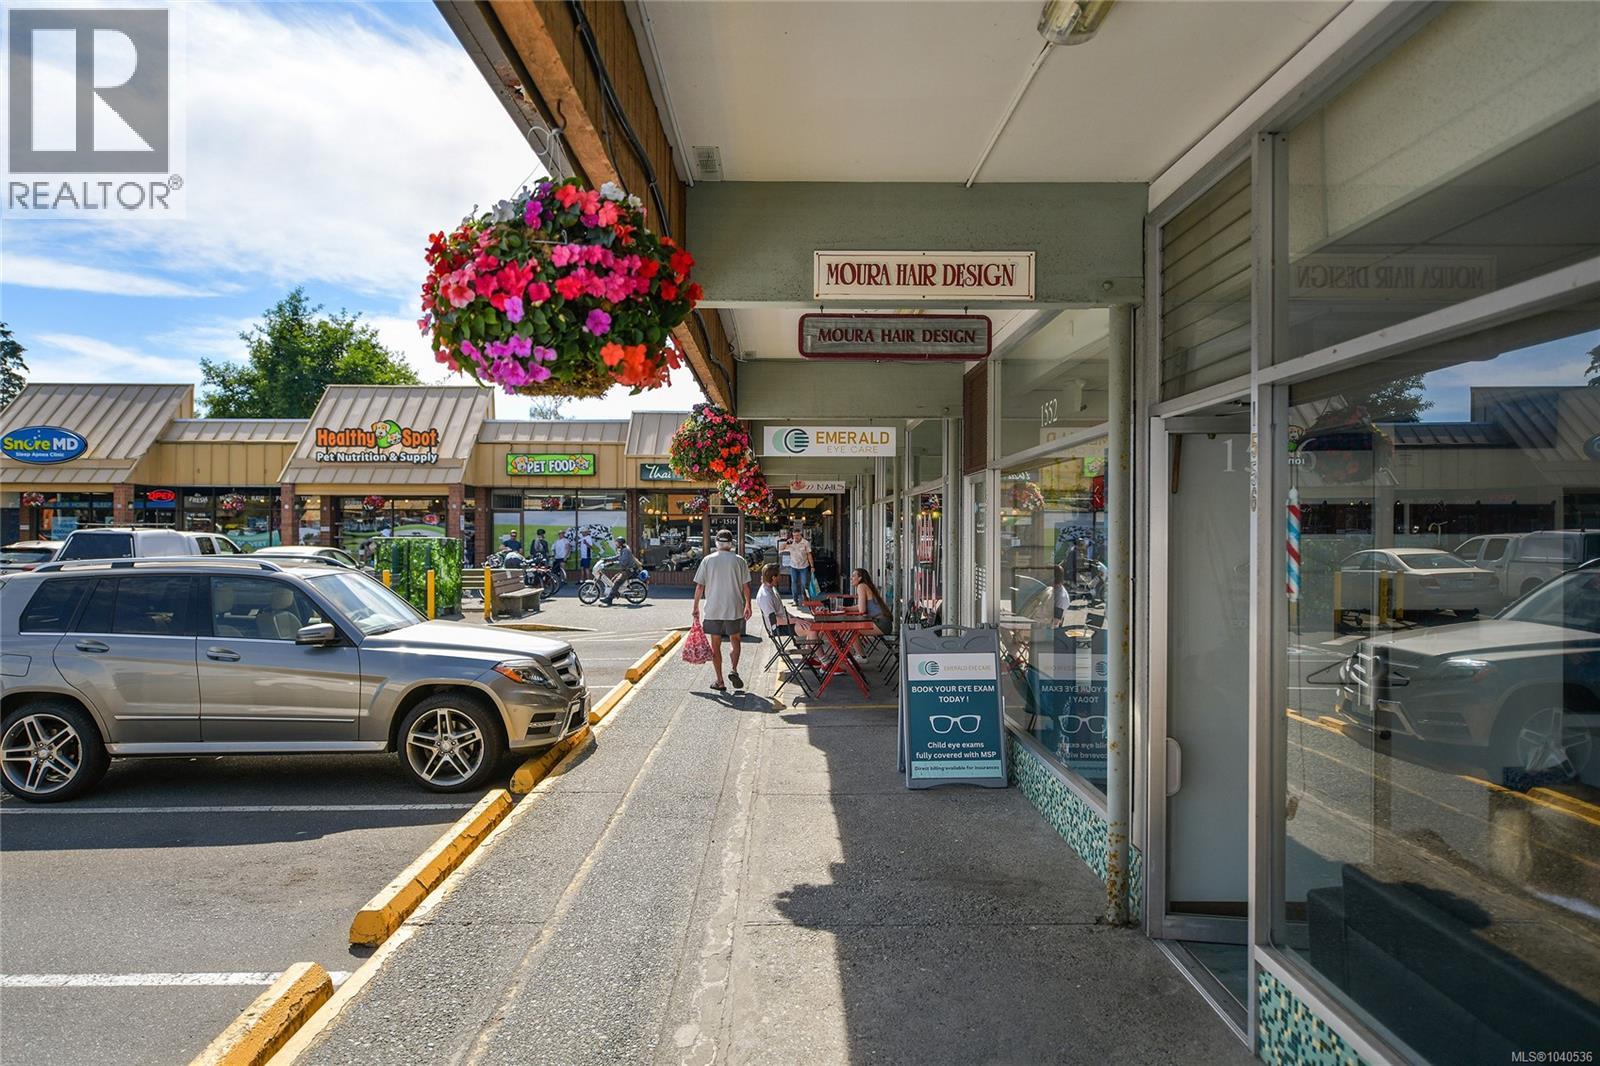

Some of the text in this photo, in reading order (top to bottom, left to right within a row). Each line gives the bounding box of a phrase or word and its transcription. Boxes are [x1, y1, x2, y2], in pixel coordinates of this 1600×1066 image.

[826, 263, 1016, 288] MOURA HAIR DESIGN
[818, 328, 976, 343] MOURA HAIR DESIGN
[1041, 398, 1058, 427] 1552
[52, 437, 79, 451] MD
[316, 427, 438, 448] Healthy Spot
[816, 431, 890, 445] EMERALD
[826, 446, 879, 454] EYE CARE
[316, 452, 438, 464] Pet Nutrition & Supply
[527, 460, 577, 473] PET FOOD
[645, 464, 672, 479] Thai
[915, 752, 932, 760] fully
